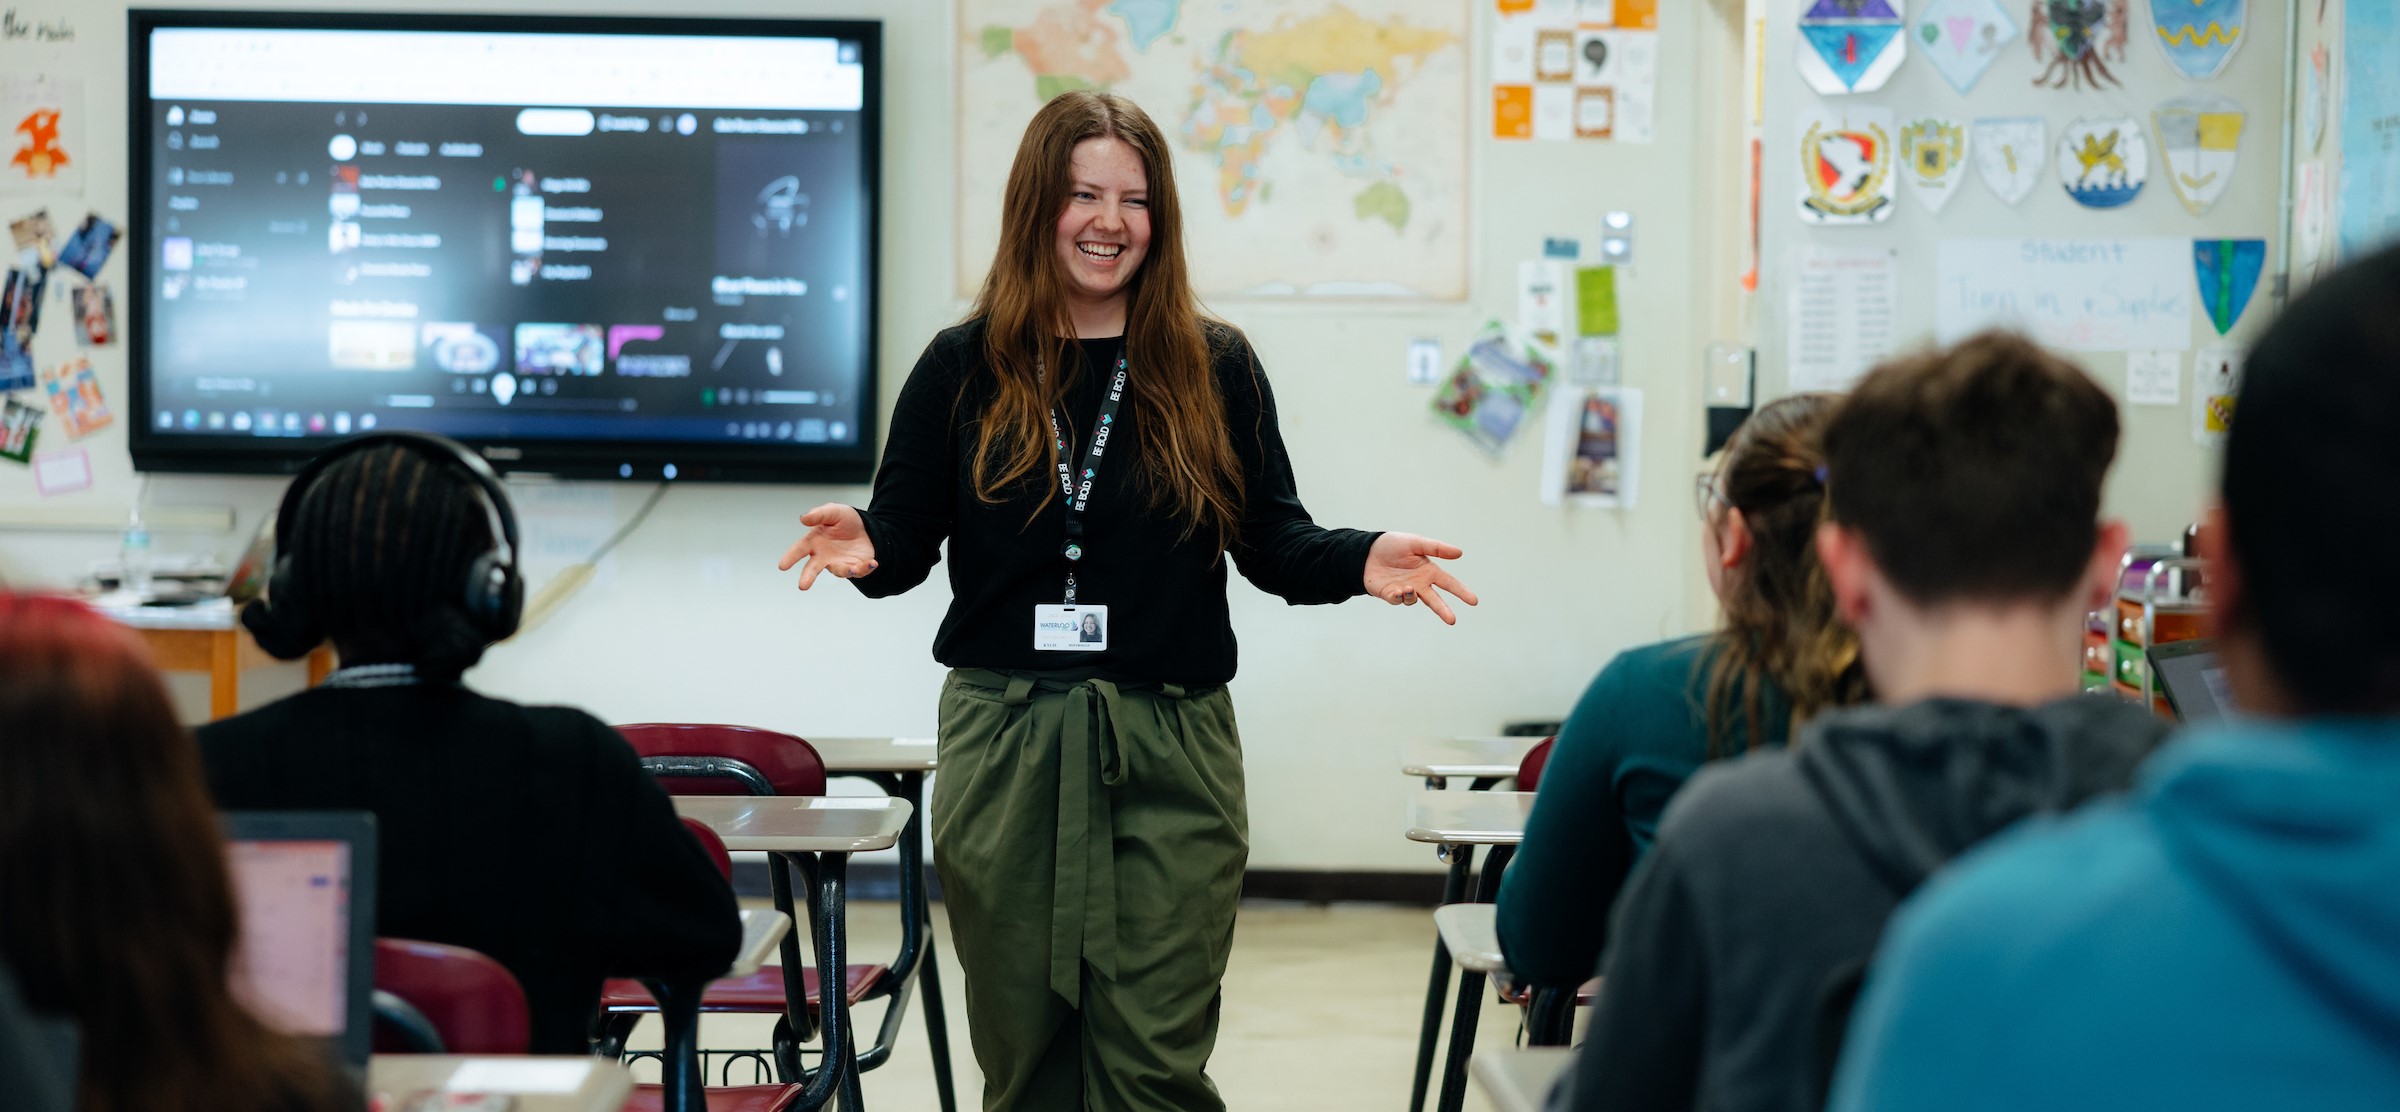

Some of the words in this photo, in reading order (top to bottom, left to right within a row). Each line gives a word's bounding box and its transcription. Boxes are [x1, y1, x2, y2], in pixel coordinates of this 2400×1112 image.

[2020, 240, 2128, 264] Student
[1951, 275, 2018, 313] Turn
[1113, 371, 1127, 392] BOLD
[1110, 391, 1121, 402] BE
[1095, 426, 1110, 447] BOLD
[1092, 446, 1103, 457] BE
[1058, 463, 1068, 473] BE
[1060, 473, 1073, 495] BOLD
[1078, 480, 1092, 501] BOLD
[1075, 500, 1086, 511] BE
